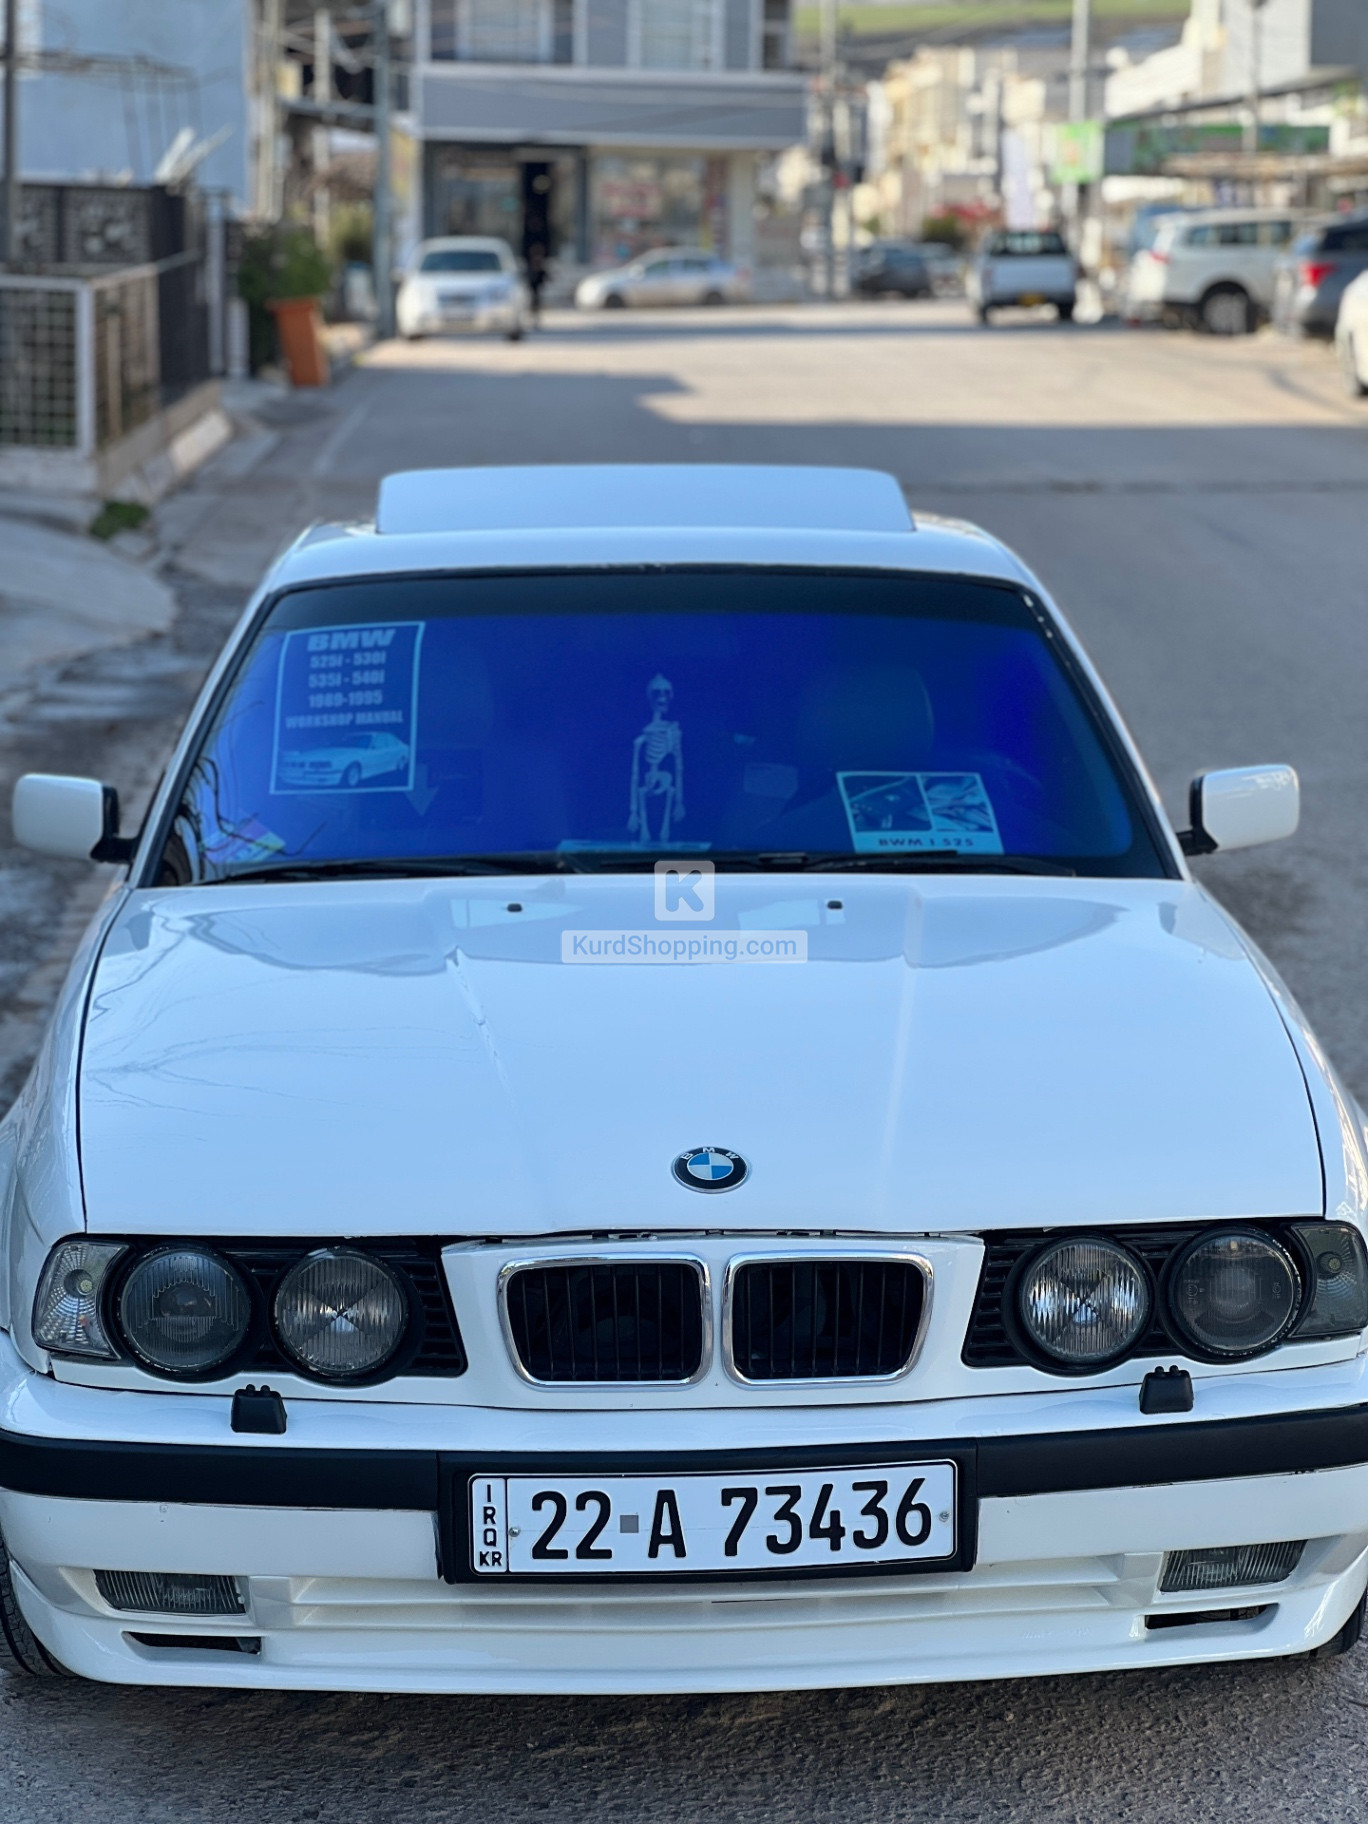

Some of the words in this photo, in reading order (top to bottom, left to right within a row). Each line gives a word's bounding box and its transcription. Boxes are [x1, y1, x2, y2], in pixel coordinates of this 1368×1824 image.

[307, 629, 396, 651] BMW
[286, 711, 353, 729] WORKSHOP
[355, 710, 403, 725] MANUAL
[681, 1147, 740, 1160] BMW
[532, 1490, 612, 1560] 22
[648, 1489, 687, 1558] A
[721, 1478, 932, 1557] 73436
[479, 1551, 502, 1566] KR
